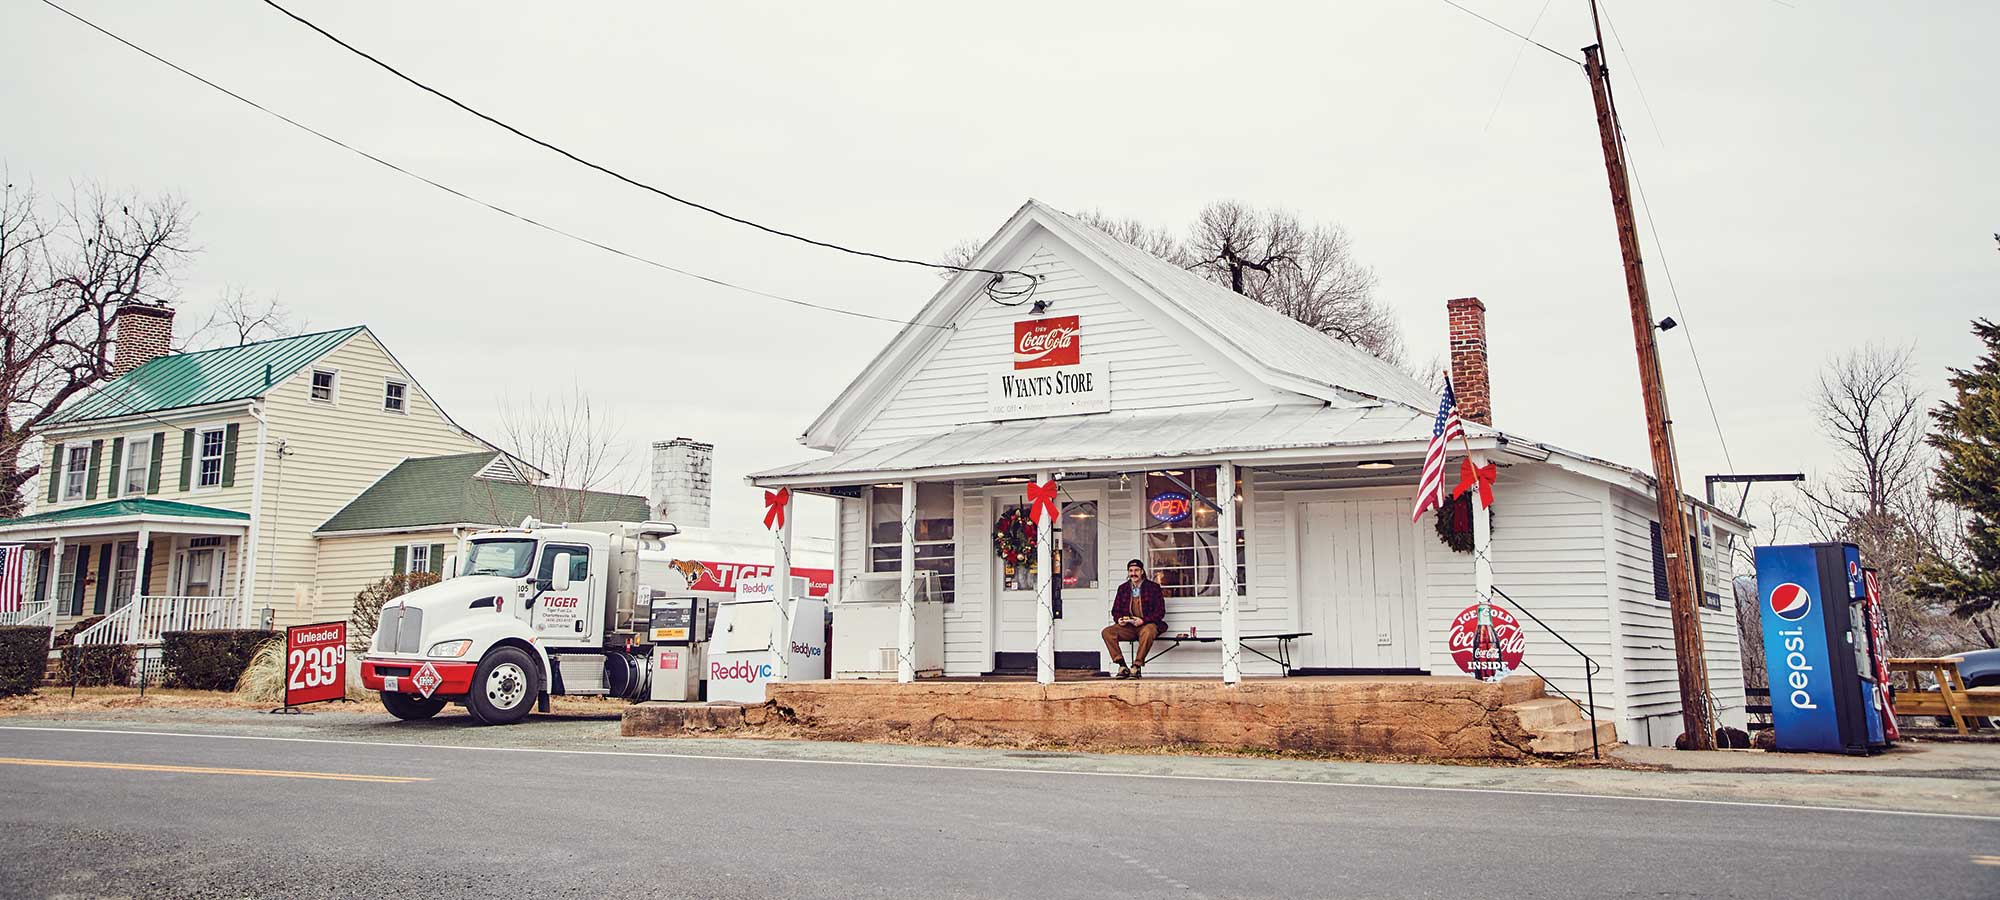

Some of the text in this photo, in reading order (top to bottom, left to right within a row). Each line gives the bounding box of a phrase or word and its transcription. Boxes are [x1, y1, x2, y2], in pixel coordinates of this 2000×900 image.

[1020, 328, 1073, 352] Coca-Cola
[1151, 500, 1190, 515] OPEN
[544, 596, 578, 608] TIGER
[1458, 608, 1513, 624] ICE COLD
[297, 629, 338, 644] Unleaded
[1467, 661, 1508, 670] INSIDE
